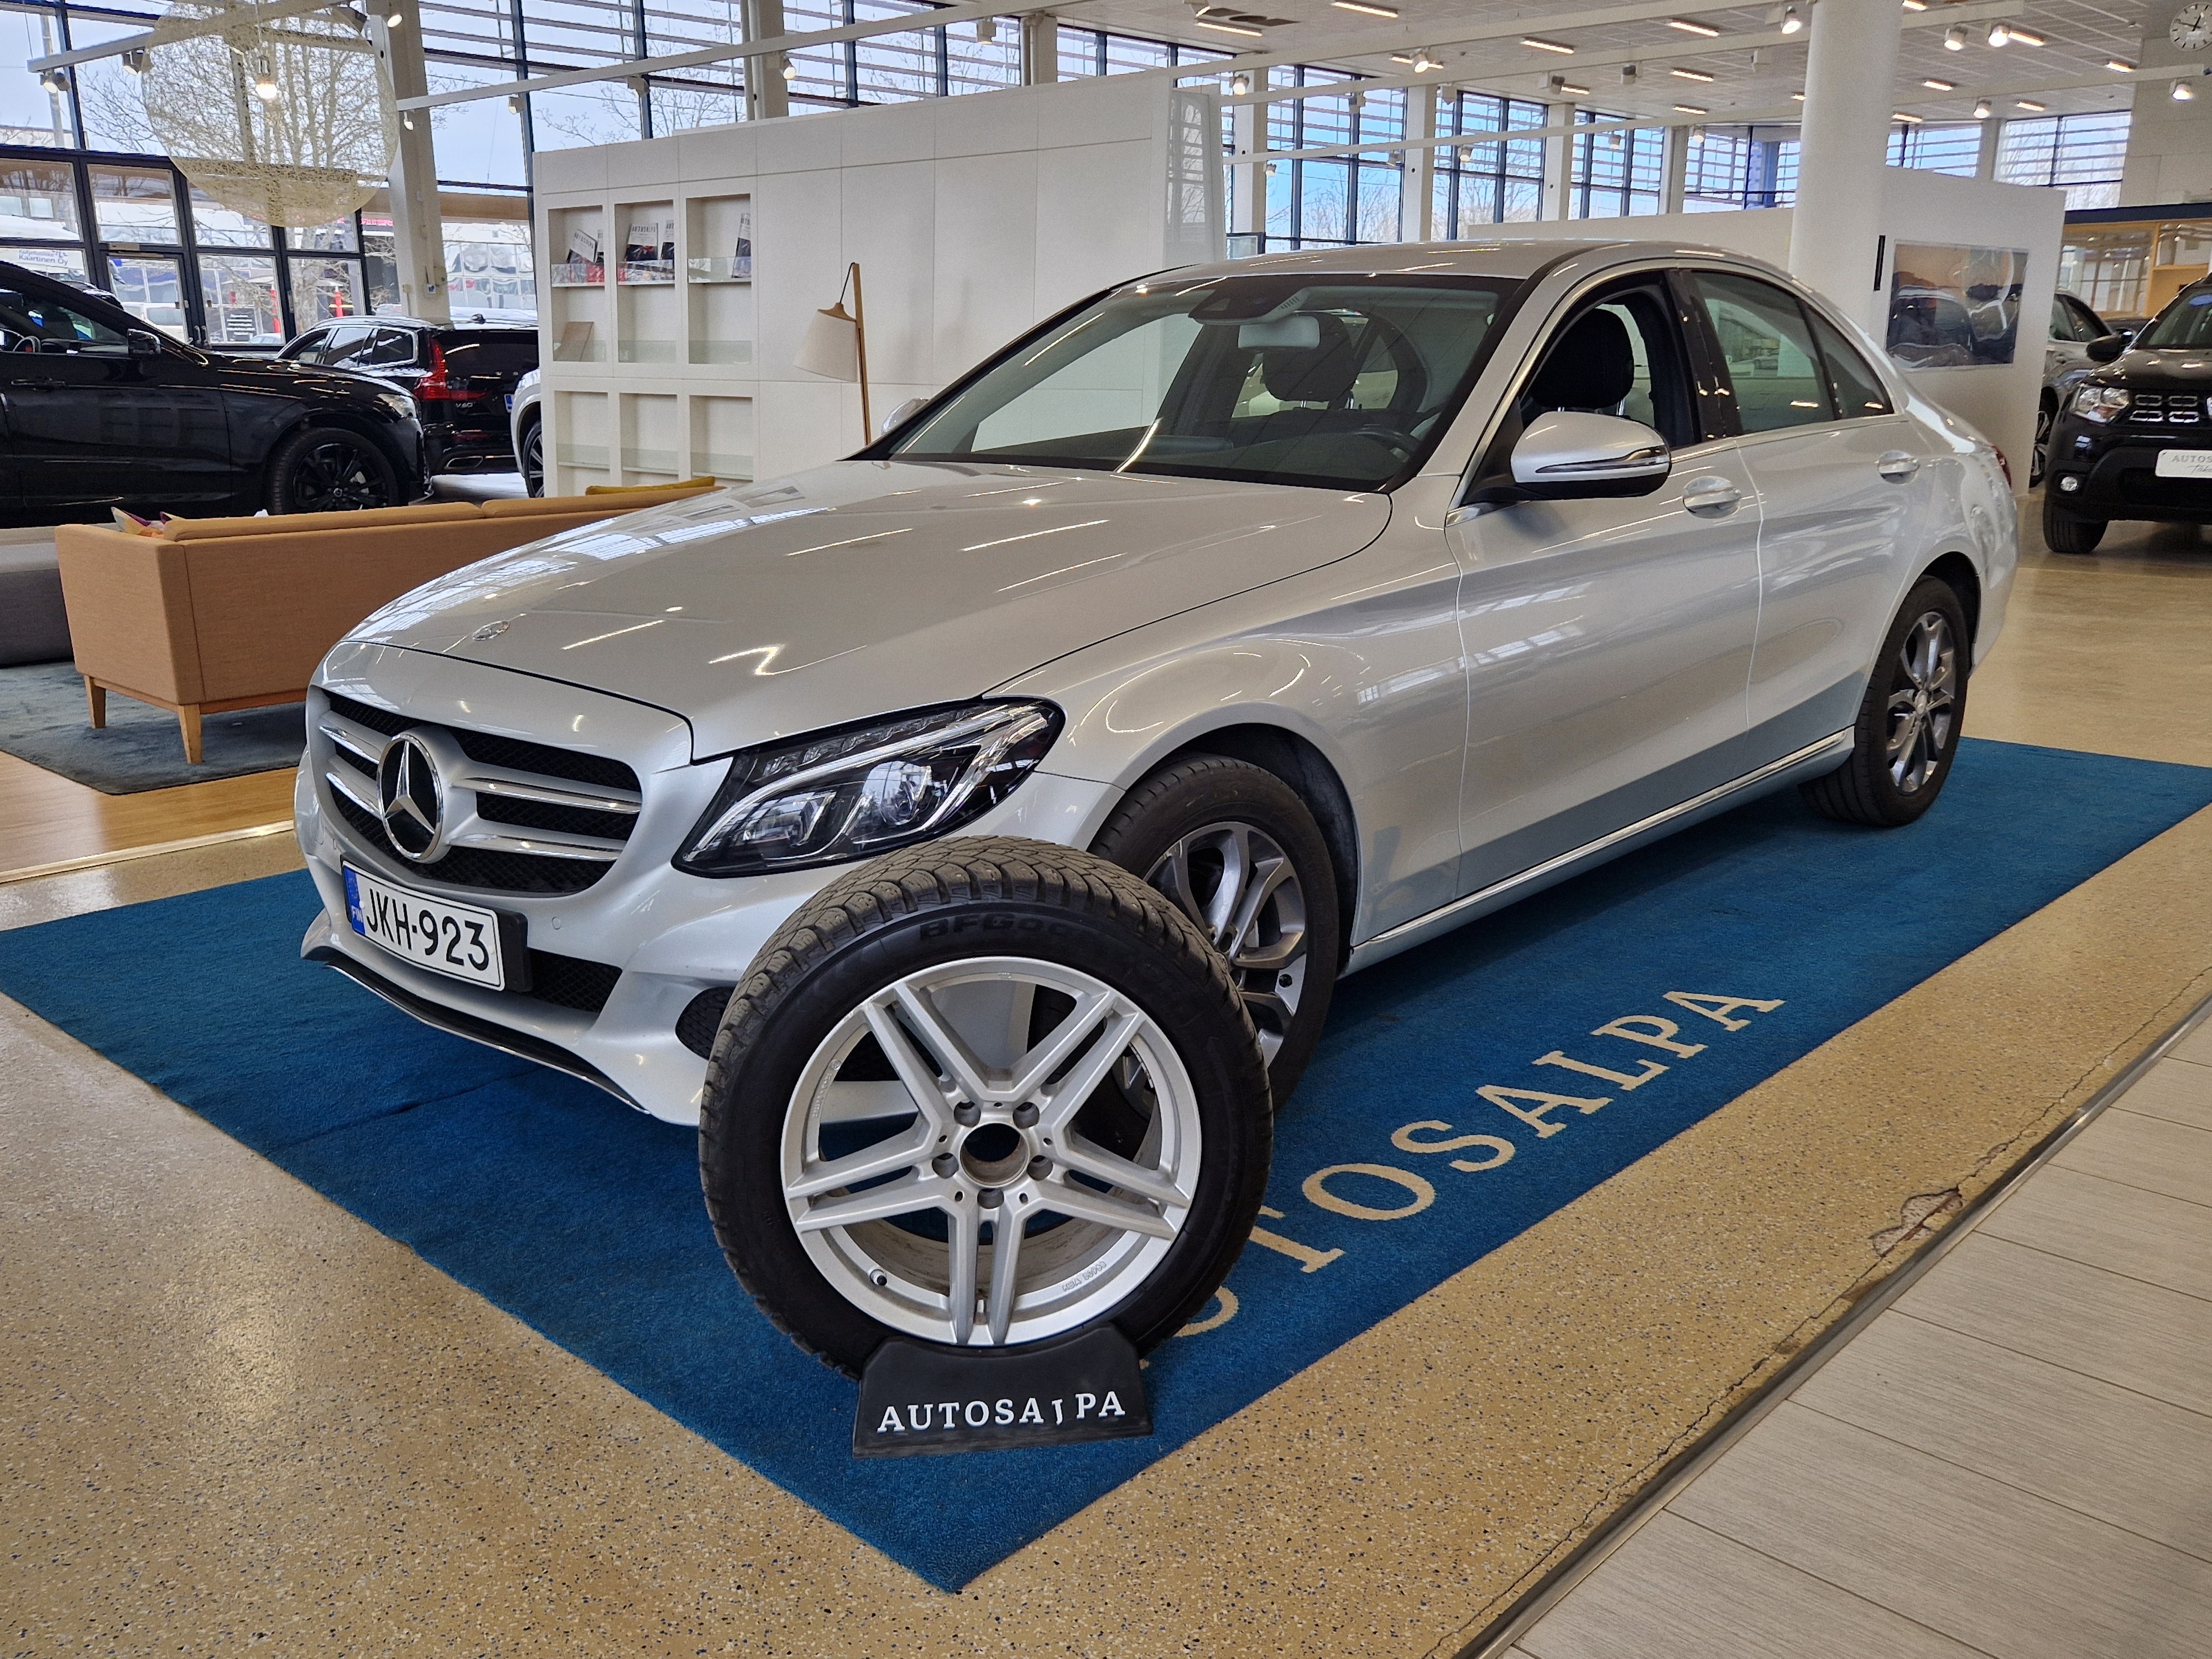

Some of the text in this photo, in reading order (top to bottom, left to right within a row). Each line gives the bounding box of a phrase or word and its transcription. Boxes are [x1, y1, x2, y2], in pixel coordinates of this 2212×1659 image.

[19, 254, 55, 263] Kaartinen
[366, 888, 489, 971] JKH-923
[1140, 990, 1787, 1370] TOSALPA
